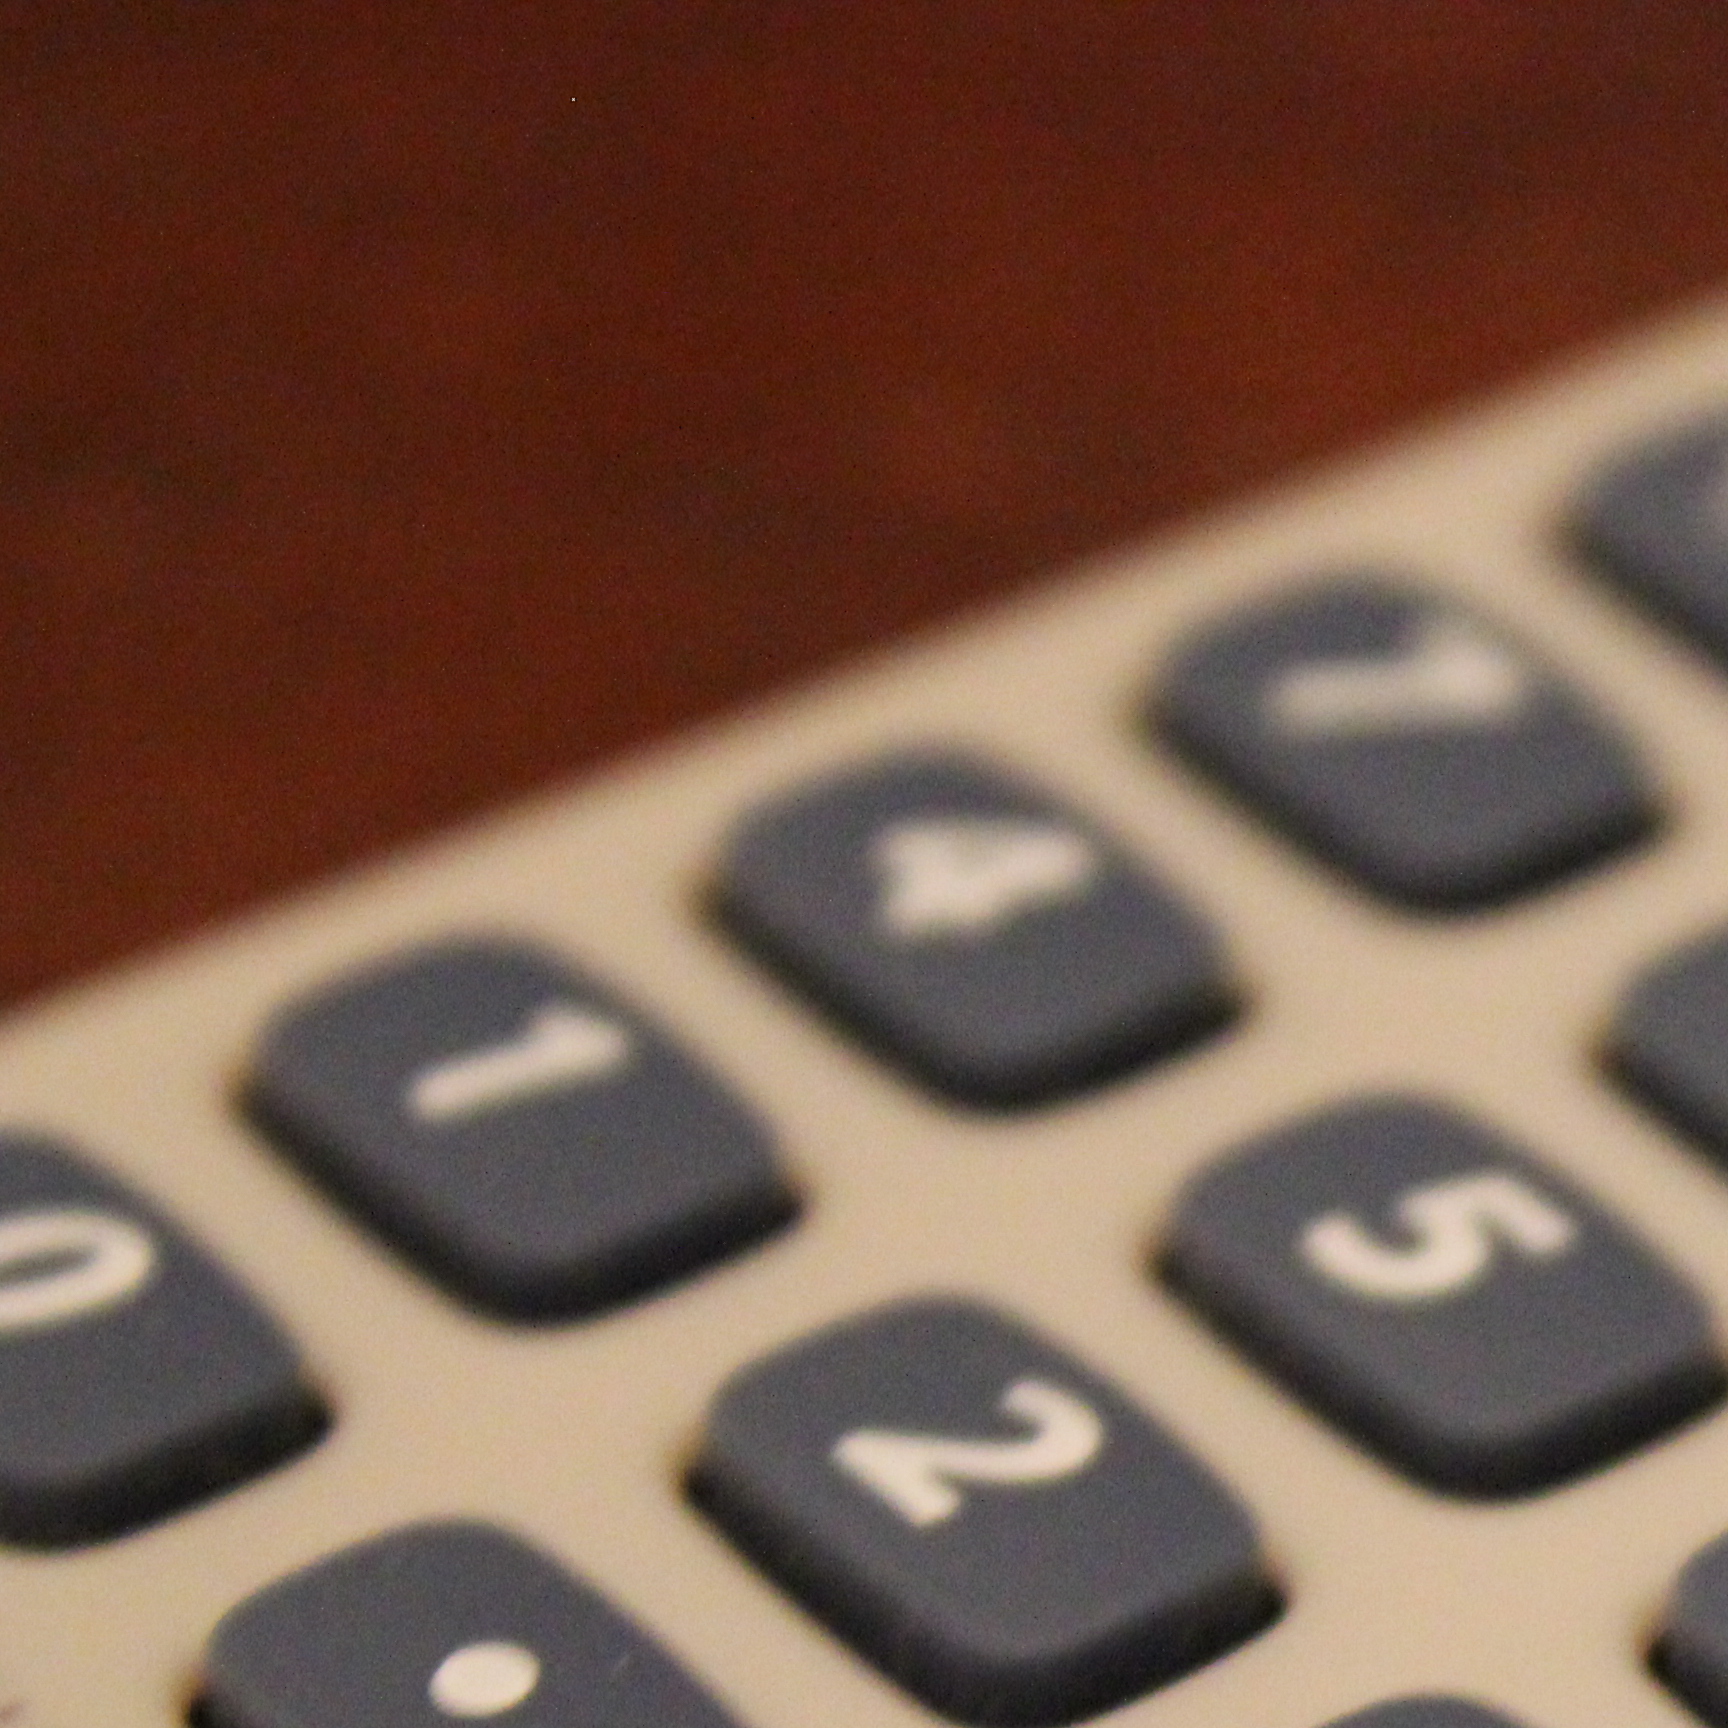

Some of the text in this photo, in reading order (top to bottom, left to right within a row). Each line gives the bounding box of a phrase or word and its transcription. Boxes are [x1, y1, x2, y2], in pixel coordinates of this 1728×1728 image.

[872, 815, 1102, 936] 4
[408, 1003, 628, 1121] 1
[1298, 1165, 1584, 1302] 5
[830, 1376, 1104, 1528] 2
